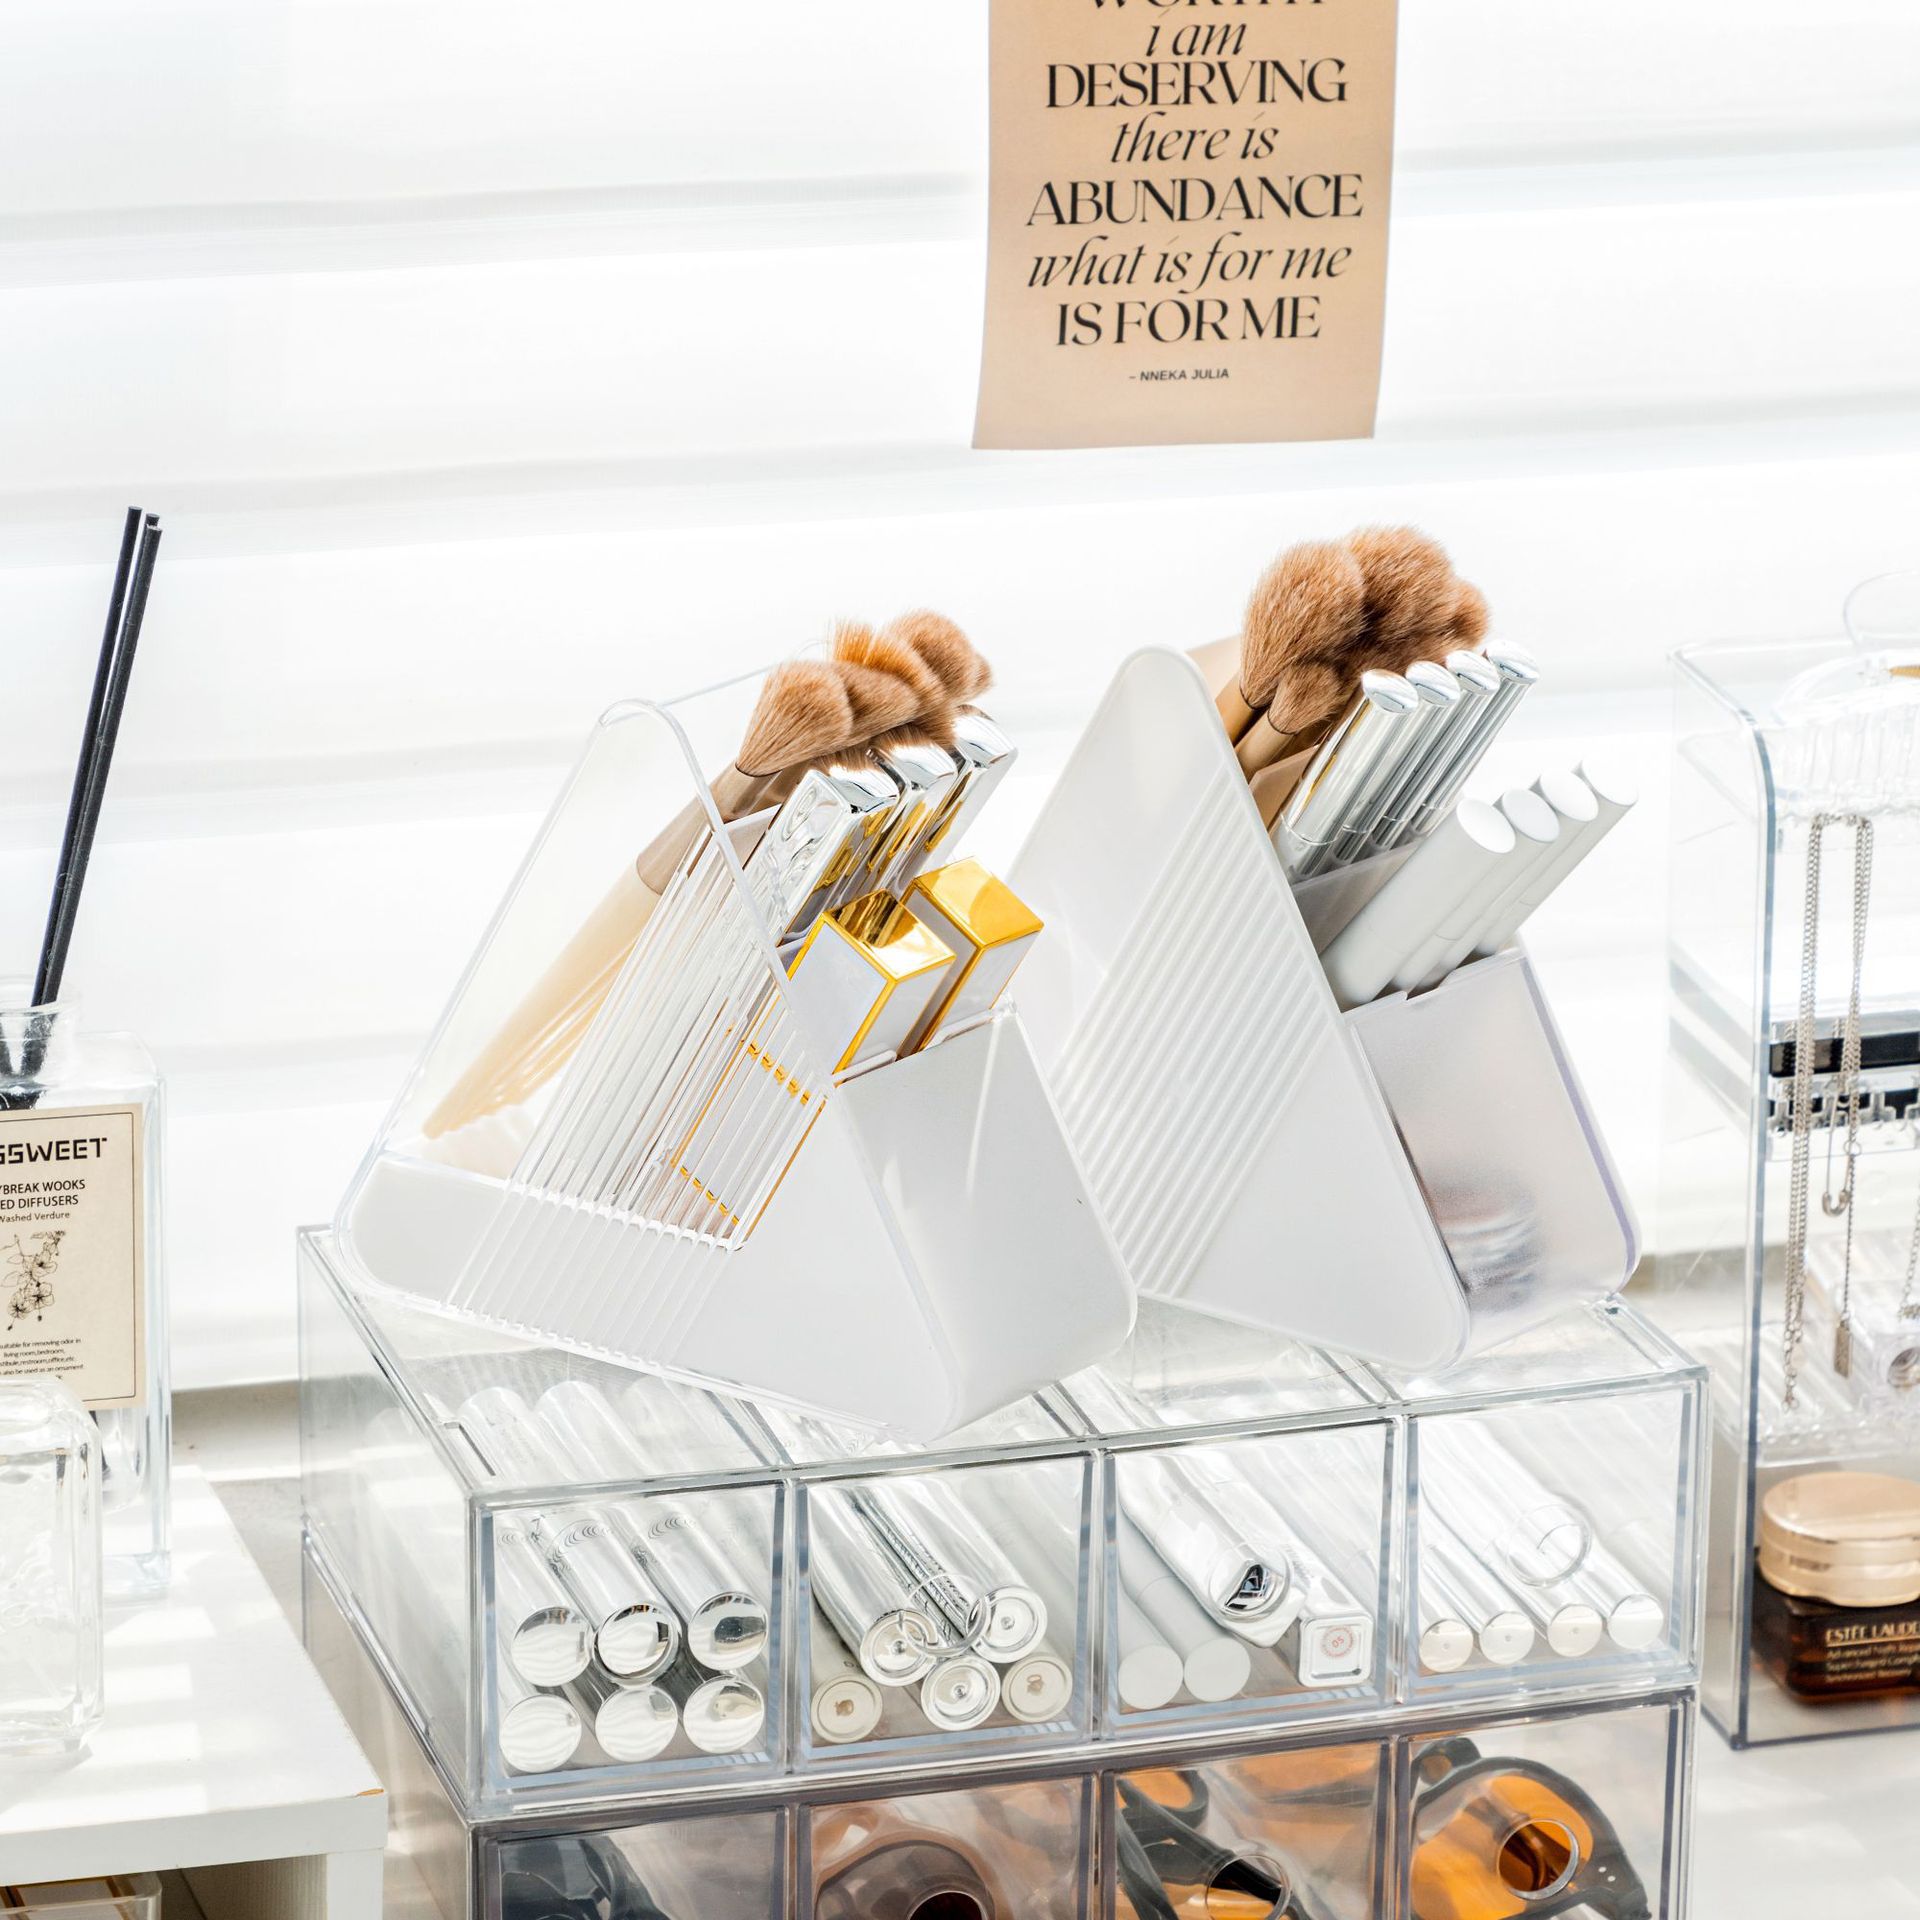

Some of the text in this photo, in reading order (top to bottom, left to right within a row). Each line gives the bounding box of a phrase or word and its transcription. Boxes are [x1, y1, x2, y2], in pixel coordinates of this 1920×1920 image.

[1145, 9, 1247, 57] i am
[1045, 57, 1348, 109] DESERVING
[1109, 110, 1280, 163] there is
[1026, 173, 1364, 227] ABUNDANCE
[1027, 231, 1352, 295] what is for me
[1055, 295, 1321, 347] IS FOR ME
[1139, 369, 1187, 382] NNEKA
[1191, 368, 1230, 381] JULIA
[18, 1195, 79, 1209] DIFFUSERS
[42, 1179, 86, 1193] WOOKS
[34, 1211, 71, 1221] Verdure
